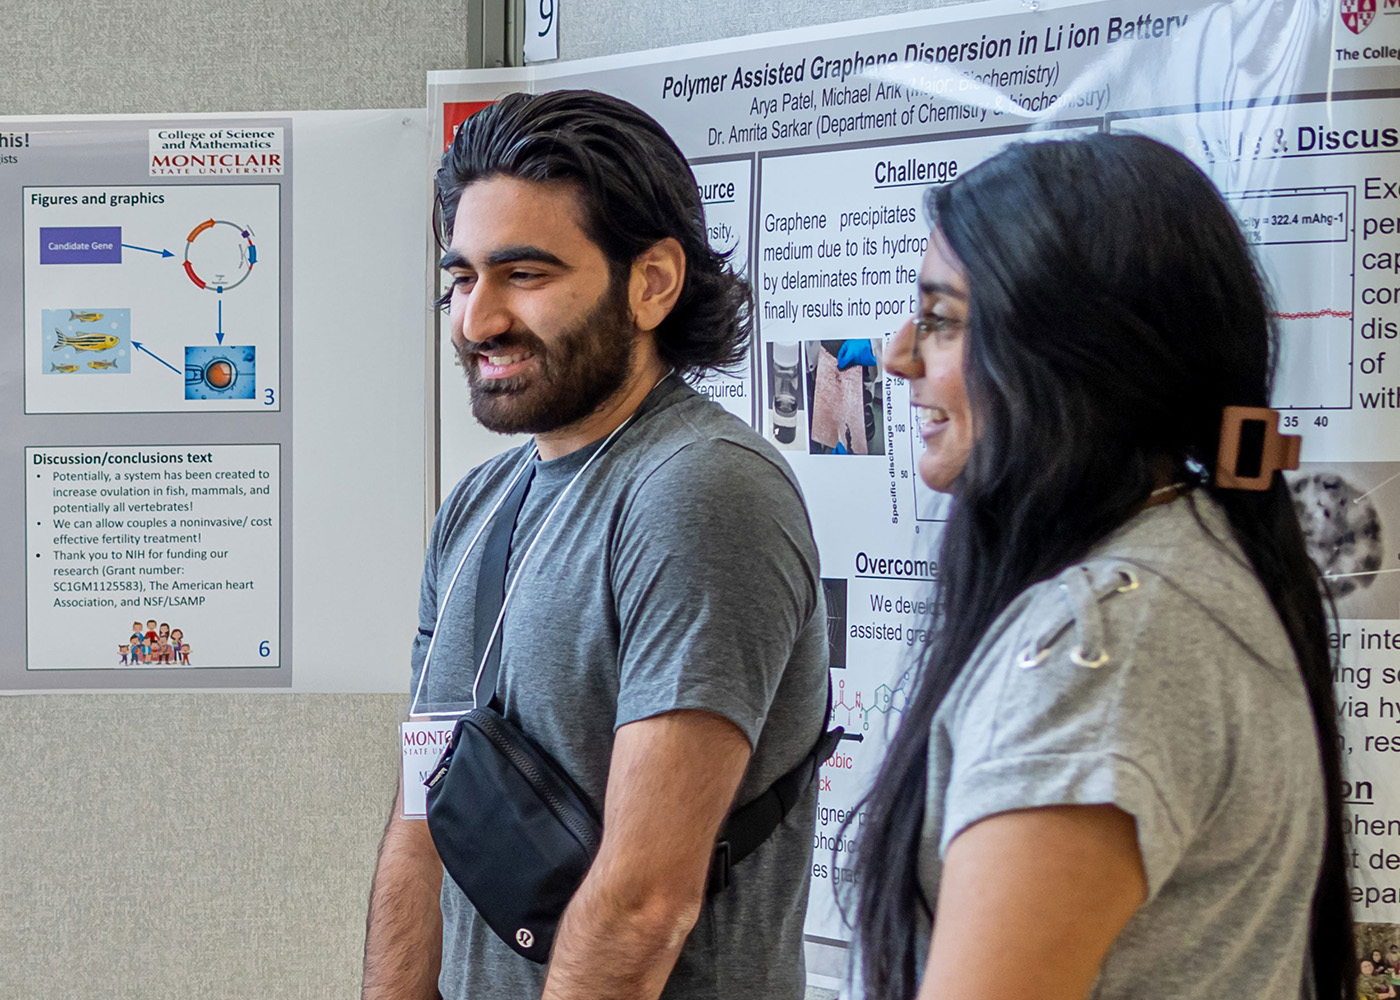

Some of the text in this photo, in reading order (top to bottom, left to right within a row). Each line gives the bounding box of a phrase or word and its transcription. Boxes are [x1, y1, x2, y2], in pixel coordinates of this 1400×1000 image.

[538, 0, 553, 37] 9
[662, 74, 727, 102] Polymer
[732, 58, 805, 90] Assisted
[810, 46, 898, 82] Graphene
[904, 35, 1011, 64] Dispersion
[1018, 30, 1038, 56] in
[1044, 25, 1063, 53] Li
[1067, 24, 1100, 49] ion
[1336, 48, 1360, 60] The
[750, 97, 777, 118] Arya
[782, 90, 817, 112] Patel,
[822, 83, 871, 107] Michael
[875, 82, 902, 101] Arik
[158, 130, 275, 140] College of Science
[708, 128, 725, 146] Dr.
[728, 123, 768, 144] Amrita
[771, 118, 813, 139] Sarkar
[816, 108, 898, 138] (Department
[901, 106, 915, 126] of
[162, 139, 271, 149] and Mathematics
[152, 154, 281, 167] MONTCLAIR
[874, 158, 959, 184] Challenge
[699, 181, 735, 200] ource
[31, 192, 165, 208] Figures and graphics
[765, 206, 916, 233] Graphene precipitates
[1271, 214, 1299, 226] 322.4
[1301, 212, 1343, 225] mAhg-1
[707, 222, 734, 243] nsity.
[48, 242, 113, 251] Candidate Gene
[764, 242, 813, 261] medium
[818, 240, 841, 259] due
[846, 239, 858, 257] to
[863, 237, 877, 256] its
[764, 265, 917, 293] by delaminates from the
[764, 300, 798, 322] finally
[803, 298, 843, 318] results
[848, 298, 871, 316] into
[875, 300, 905, 319] poor
[1360, 352, 1386, 374] of
[264, 388, 275, 405] 3
[895, 424, 905, 432] 100
[1284, 416, 1328, 427] 35 40
[33, 452, 213, 466] Discussion/conclusions text
[885, 377, 898, 525] Specific discharge capacity
[900, 470, 908, 478] 50
[855, 552, 938, 577] Overcome
[149, 581, 169, 591] The
[172, 580, 223, 590] American
[226, 580, 254, 590] heart
[870, 594, 892, 612] We
[850, 622, 902, 641] assisted
[259, 640, 270, 657] 6
